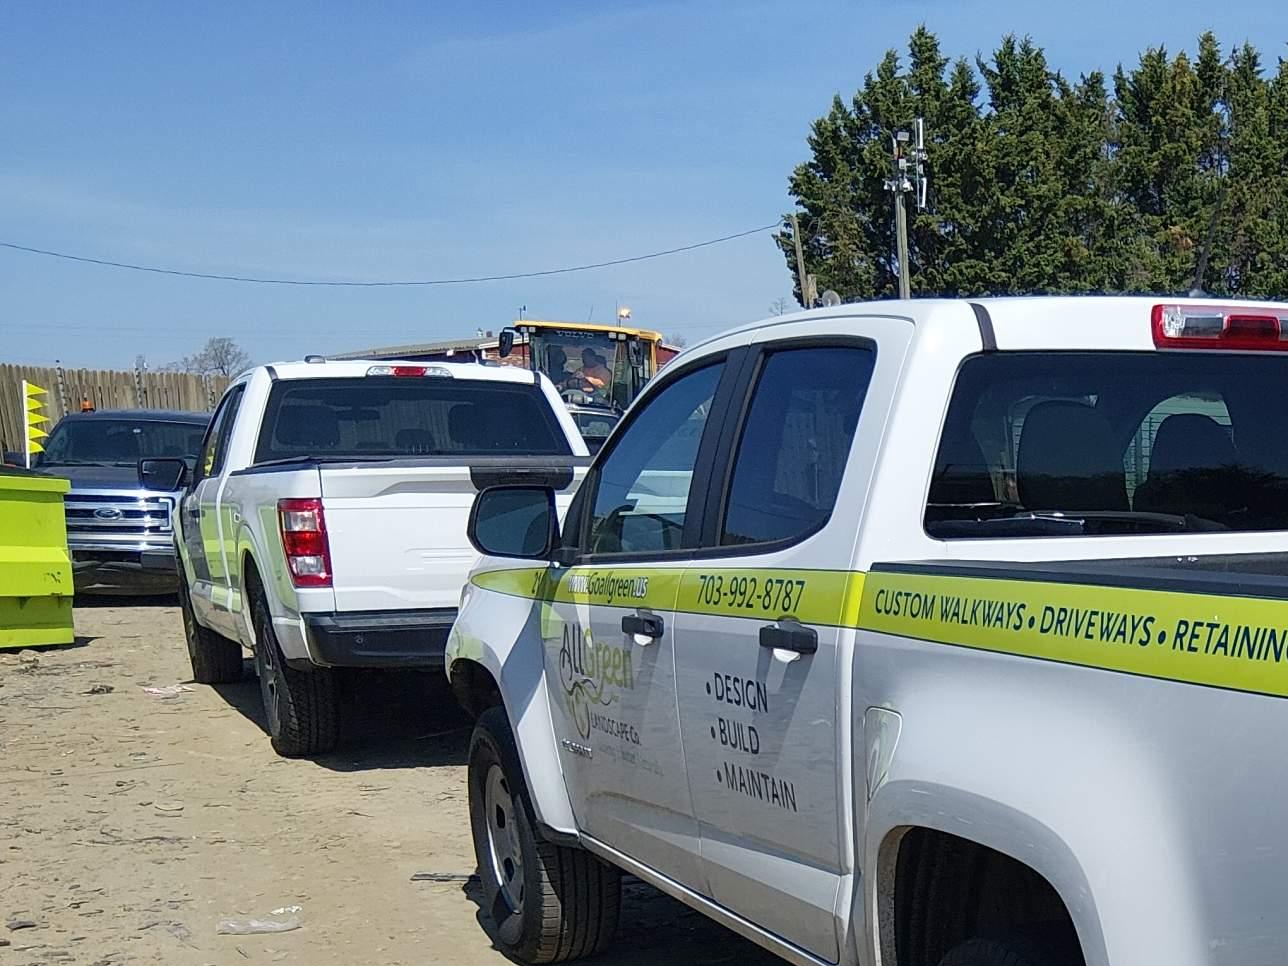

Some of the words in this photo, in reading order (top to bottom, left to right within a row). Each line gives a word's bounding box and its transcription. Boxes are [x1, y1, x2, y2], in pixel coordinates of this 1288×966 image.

[568, 571, 649, 604] www.Goallgreen.us
[697, 575, 806, 614] 703-992-8787
[875, 589, 936, 620] CUSTOM
[940, 595, 1026, 631] WALKWAYS
[1040, 606, 1155, 647] DRIVEWAYS
[713, 672, 769, 714] DESIGN
[590, 711, 630, 743] LANDSCAPE
[719, 718, 760, 755] BUILD
[724, 762, 797, 812] MAINTAIN
